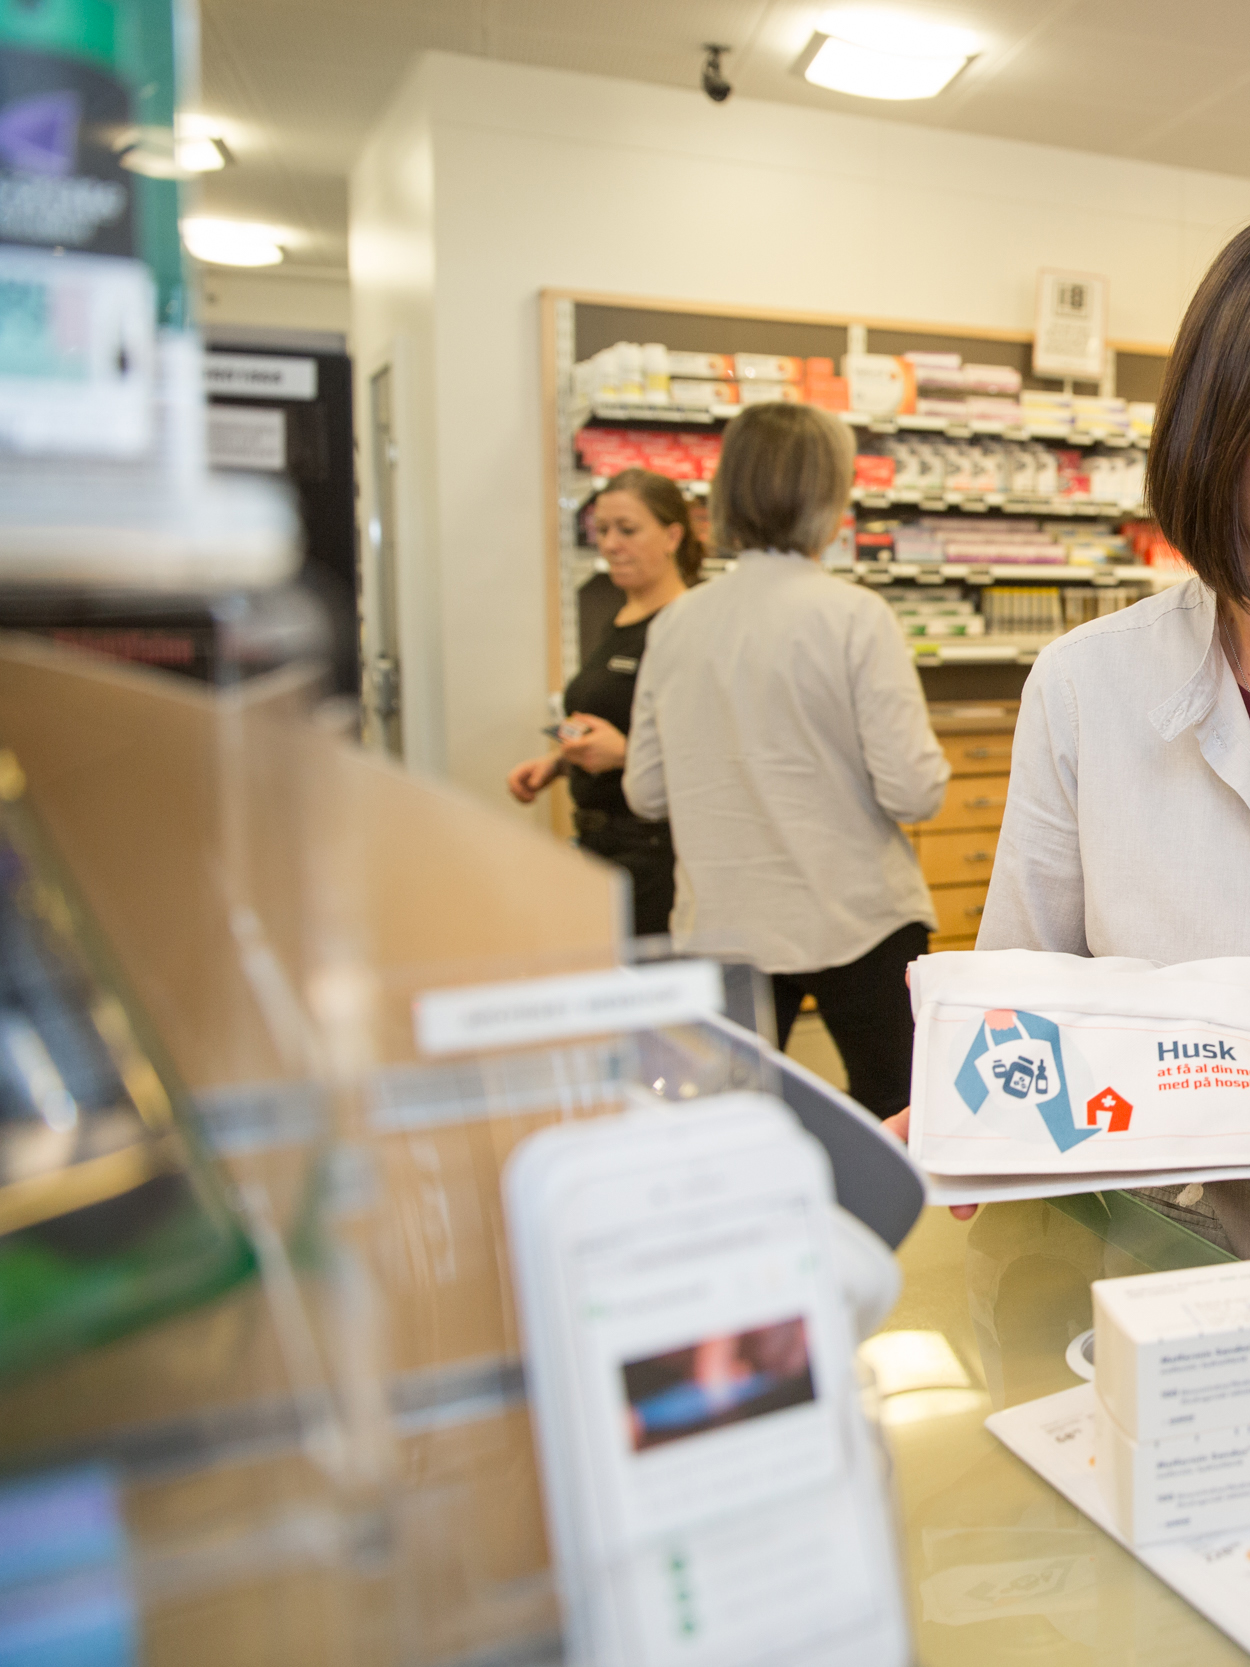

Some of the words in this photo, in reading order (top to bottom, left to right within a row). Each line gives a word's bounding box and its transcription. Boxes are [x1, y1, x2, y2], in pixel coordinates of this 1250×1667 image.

[1157, 1040, 1237, 1062] Husk
[1157, 1067, 1172, 1077] at
[1176, 1063, 1191, 1075] få
[1195, 1063, 1208, 1073] al
[1211, 1064, 1233, 1074] din
[1158, 1078, 1189, 1091] med
[1193, 1077, 1211, 1090] på
